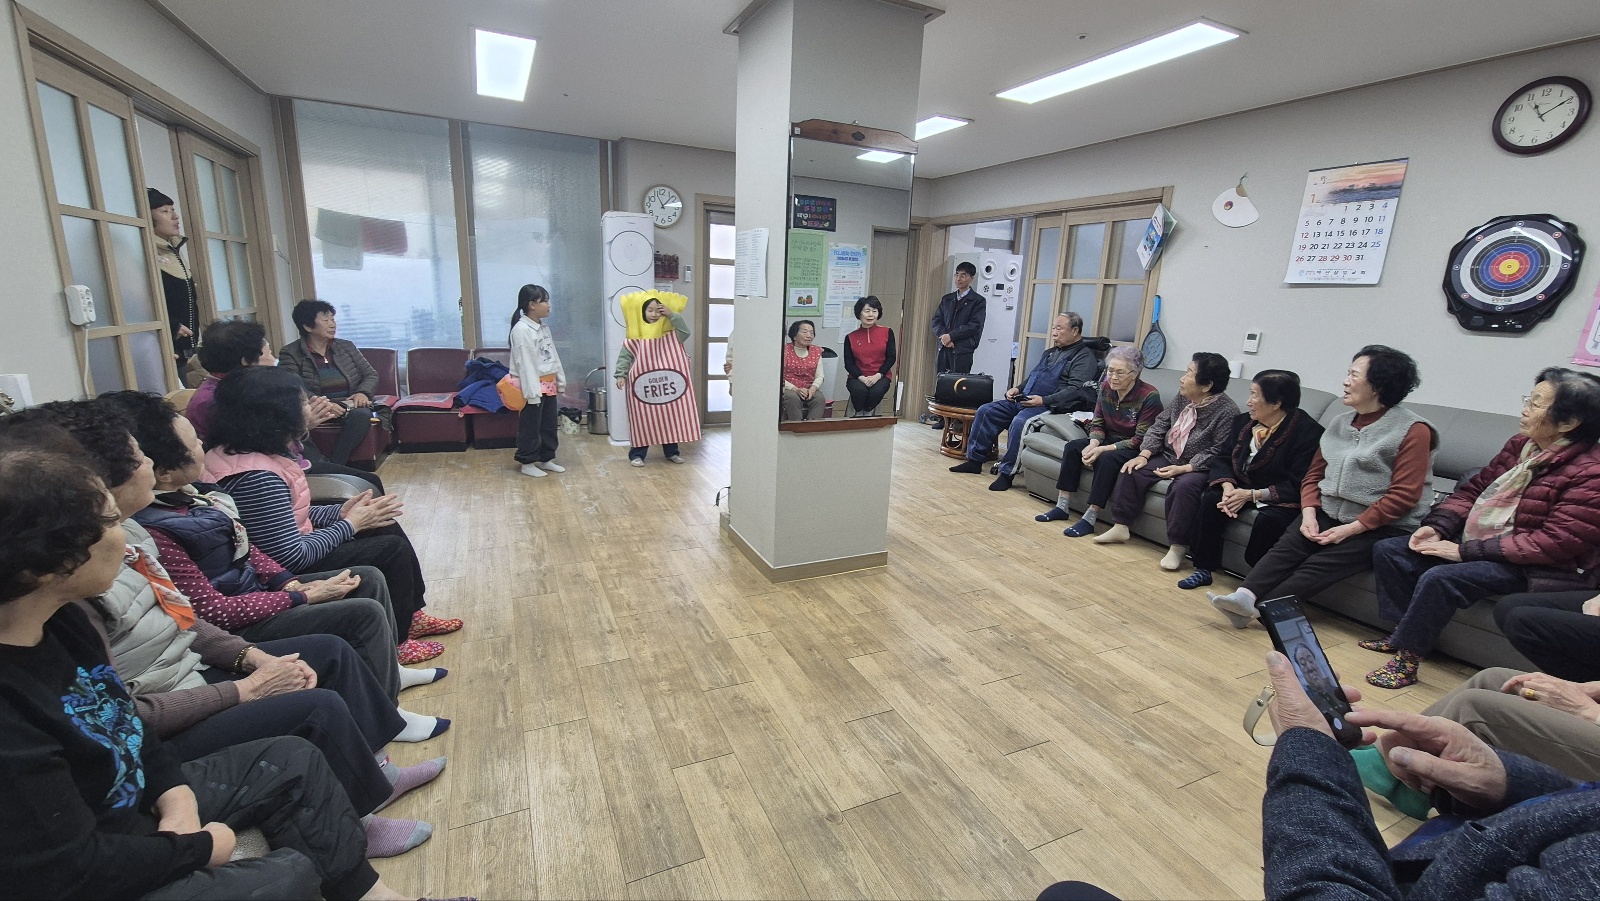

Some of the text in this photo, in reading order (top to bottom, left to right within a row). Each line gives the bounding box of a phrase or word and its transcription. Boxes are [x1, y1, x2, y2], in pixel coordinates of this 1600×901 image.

[1541, 88, 1552, 96] 12
[1567, 96, 1574, 104] 2
[1514, 104, 1523, 112] 10
[1518, 135, 1524, 143] 7
[1311, 194, 1316, 203] 1
[643, 382, 677, 399] FRIES
